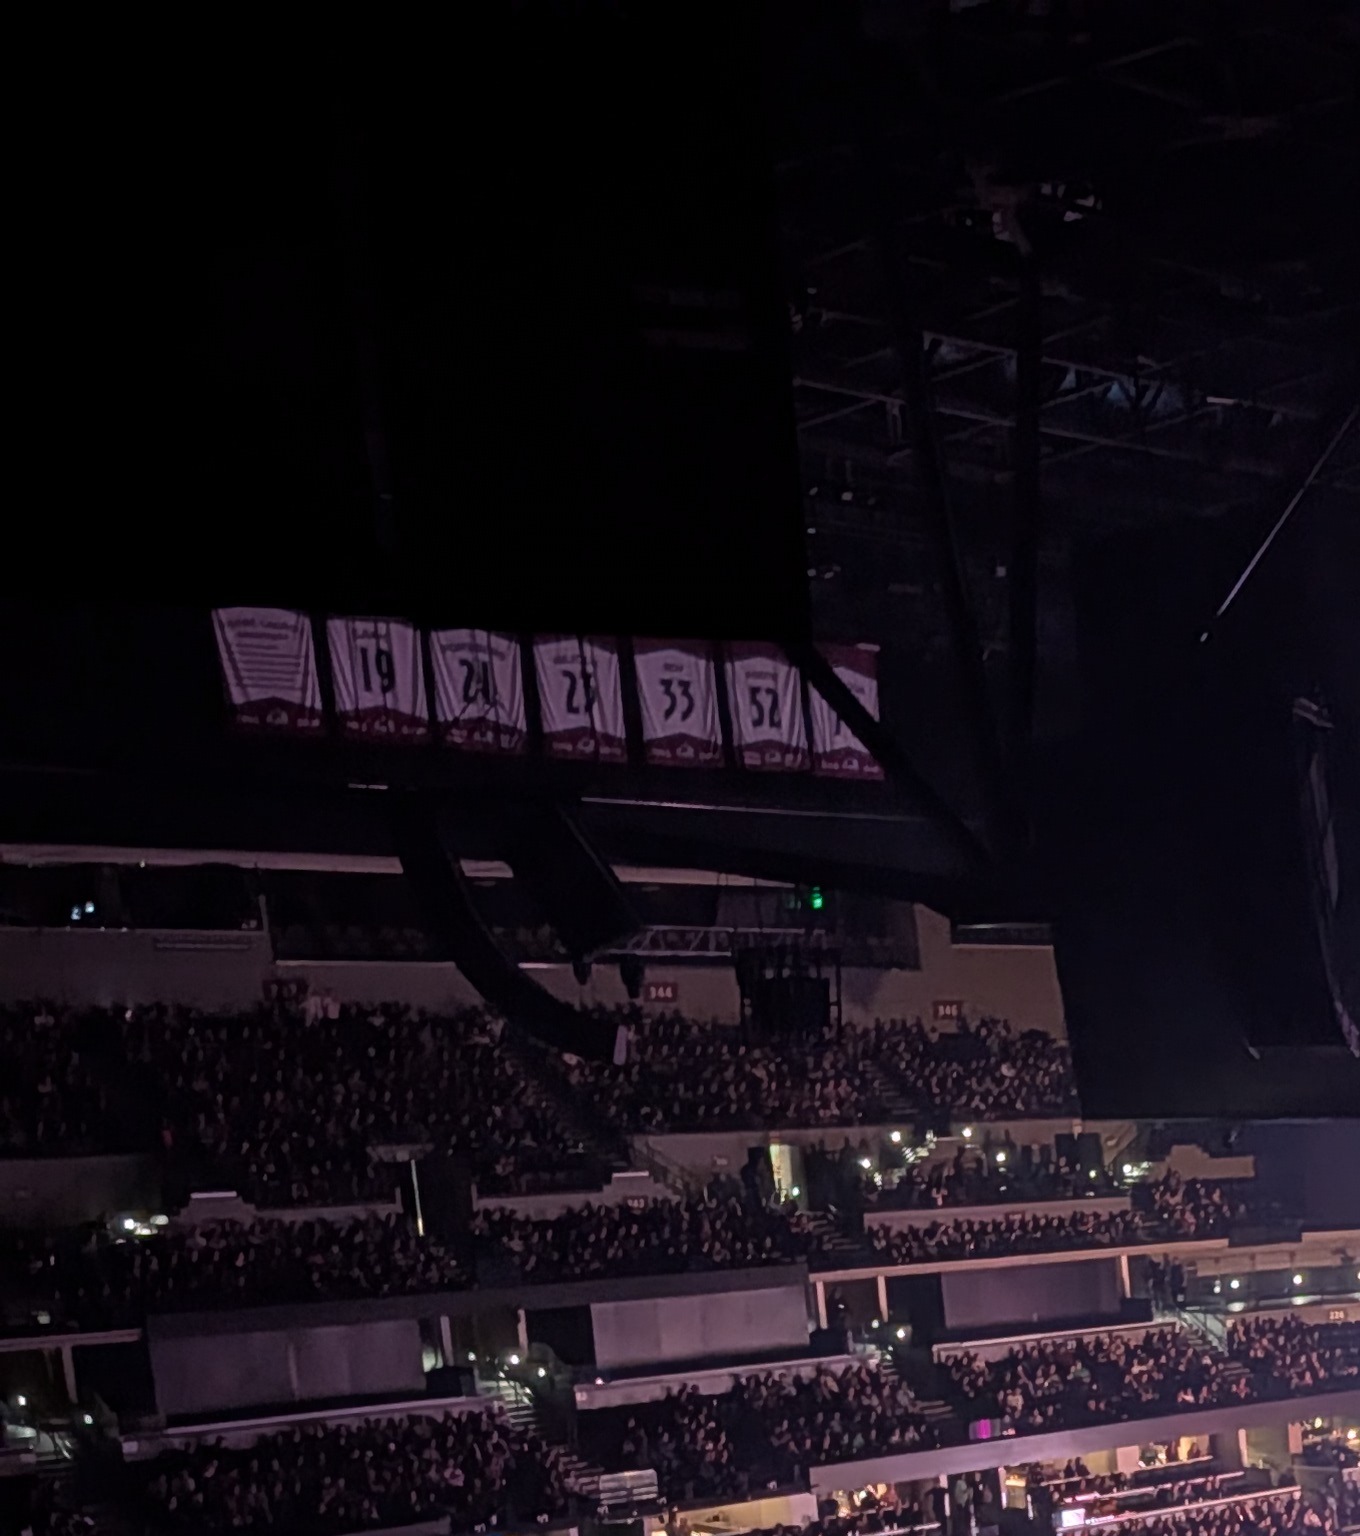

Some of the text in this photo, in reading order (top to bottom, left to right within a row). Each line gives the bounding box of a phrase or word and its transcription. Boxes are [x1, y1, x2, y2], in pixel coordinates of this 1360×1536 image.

[360, 648, 396, 694] 19
[659, 679, 695, 722] 33
[750, 687, 782, 728] 52
